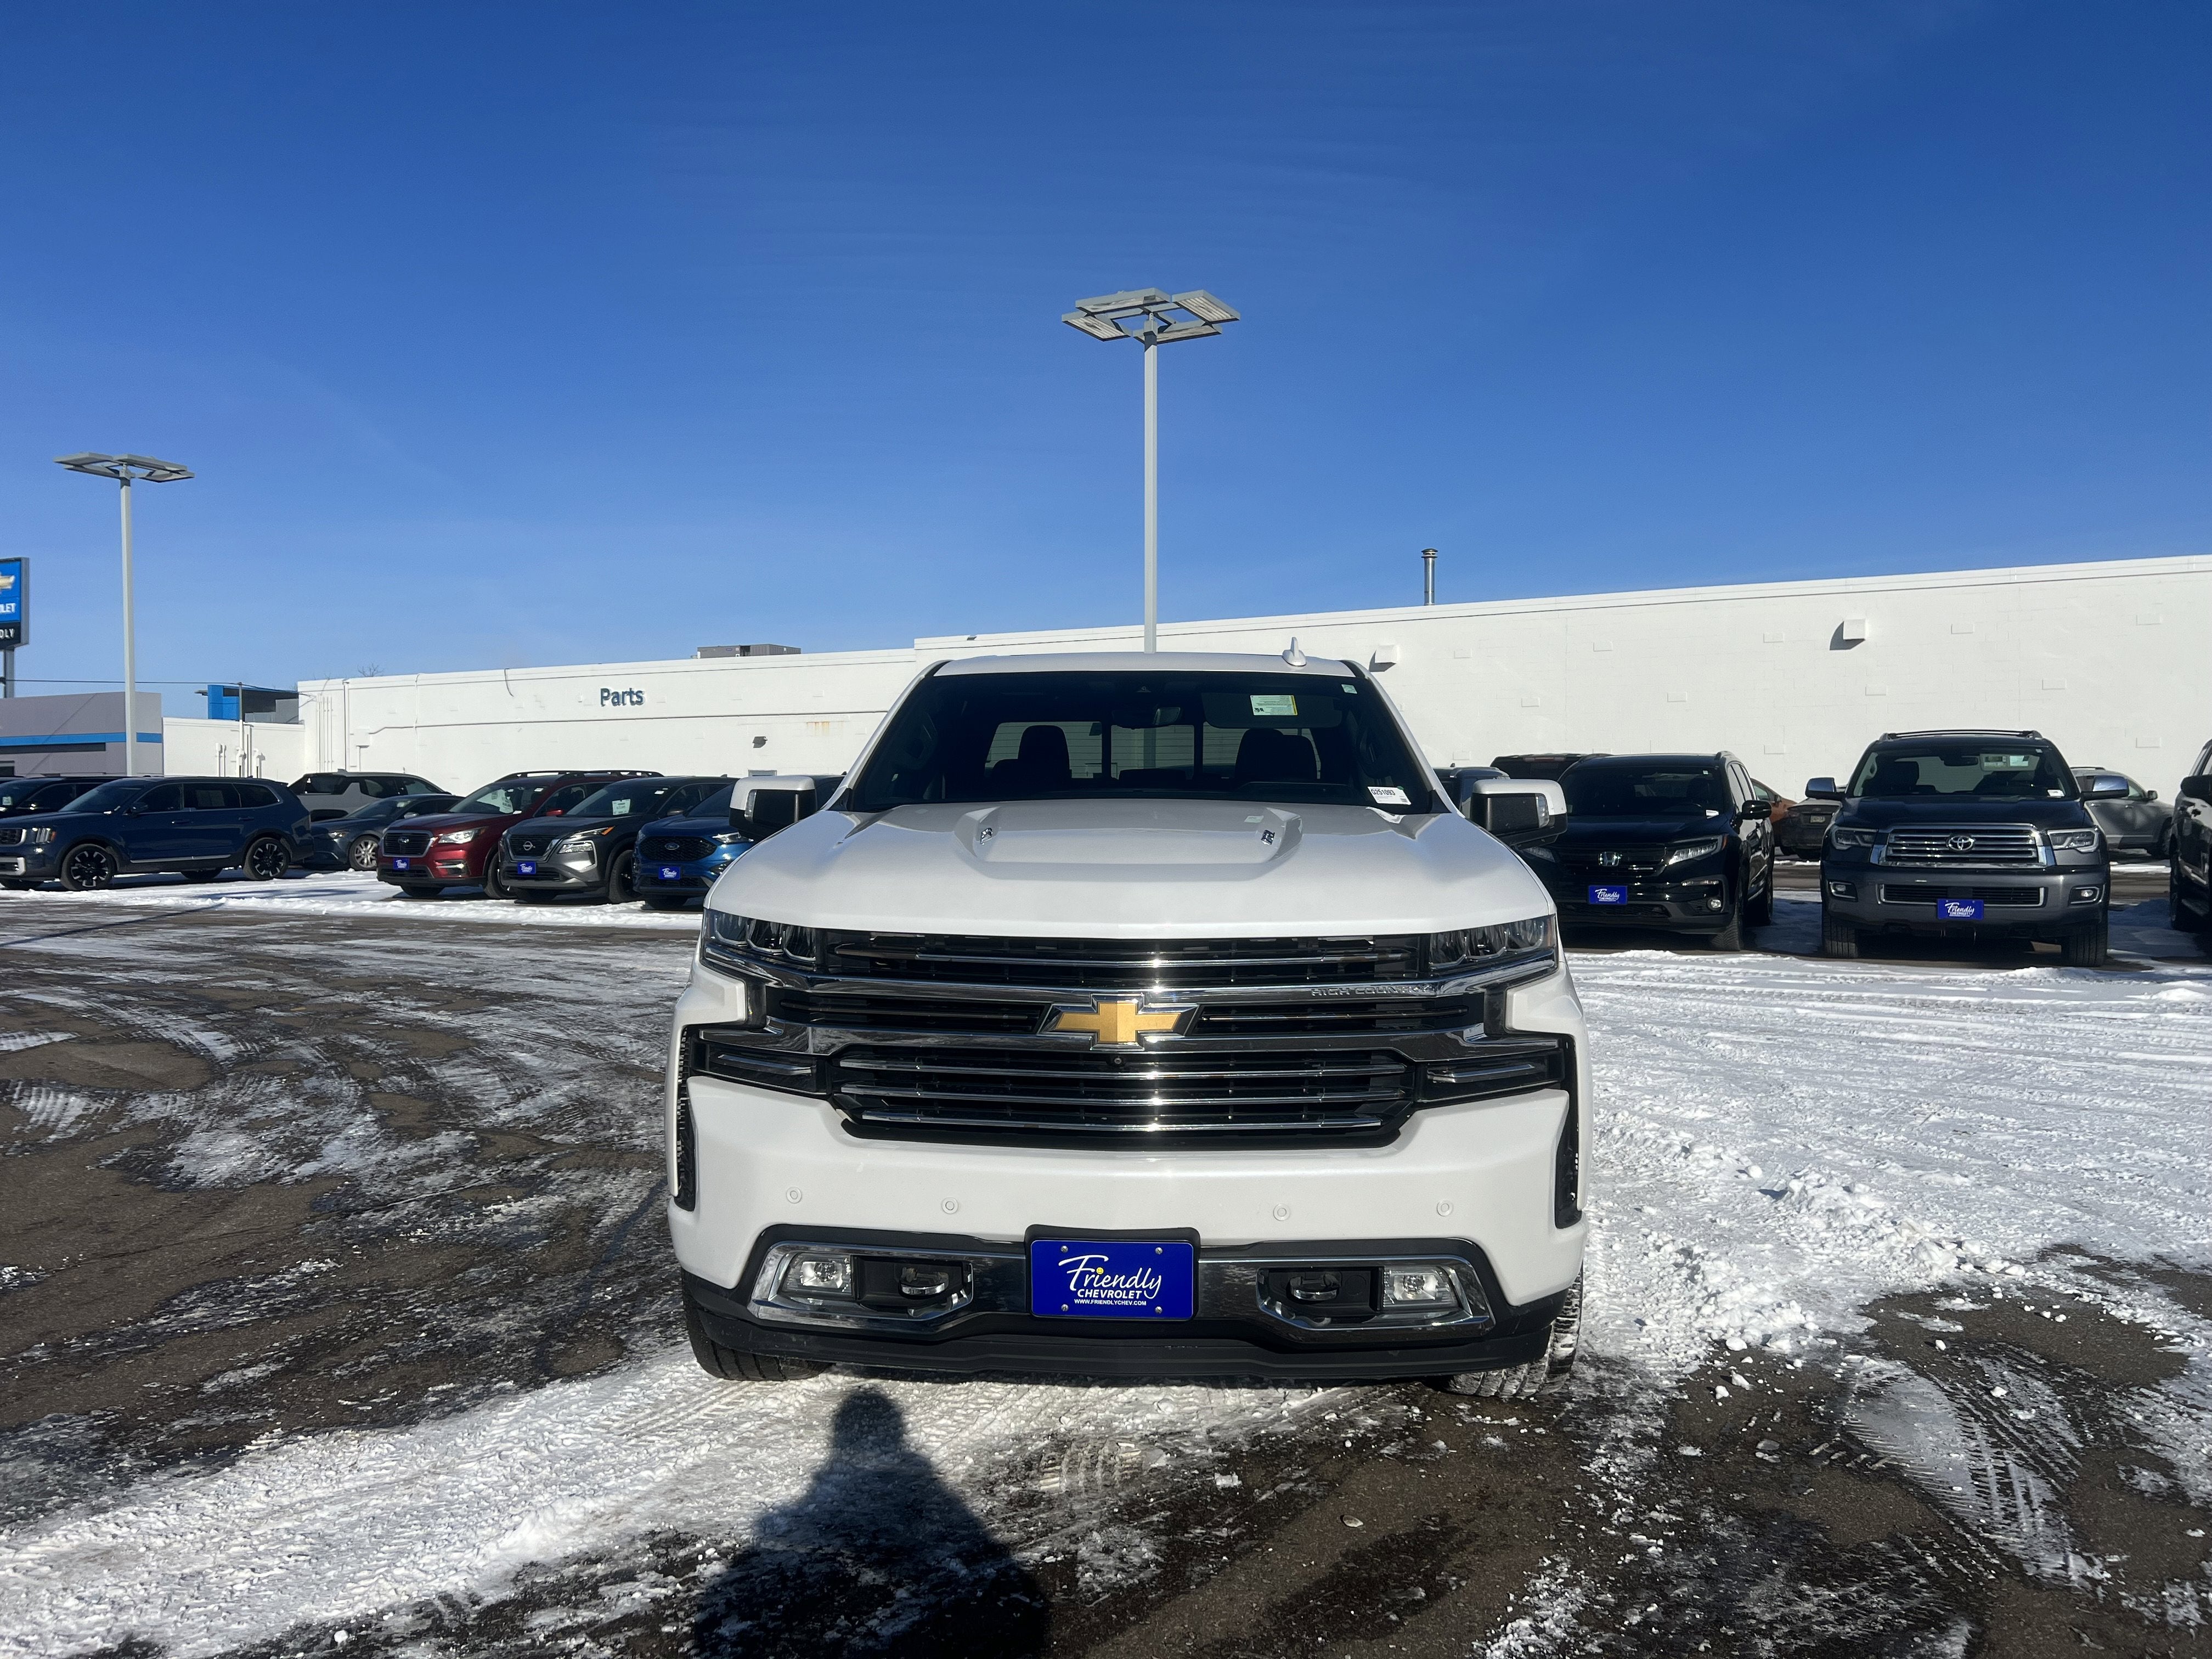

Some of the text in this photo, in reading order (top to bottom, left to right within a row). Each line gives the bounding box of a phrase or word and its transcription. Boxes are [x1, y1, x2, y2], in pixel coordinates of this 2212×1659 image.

[0, 603, 16, 613] LET
[600, 687, 644, 707] Parts
[1058, 1255, 1162, 1299] Friendly
[1077, 1288, 1142, 1300] CHEVROLET
